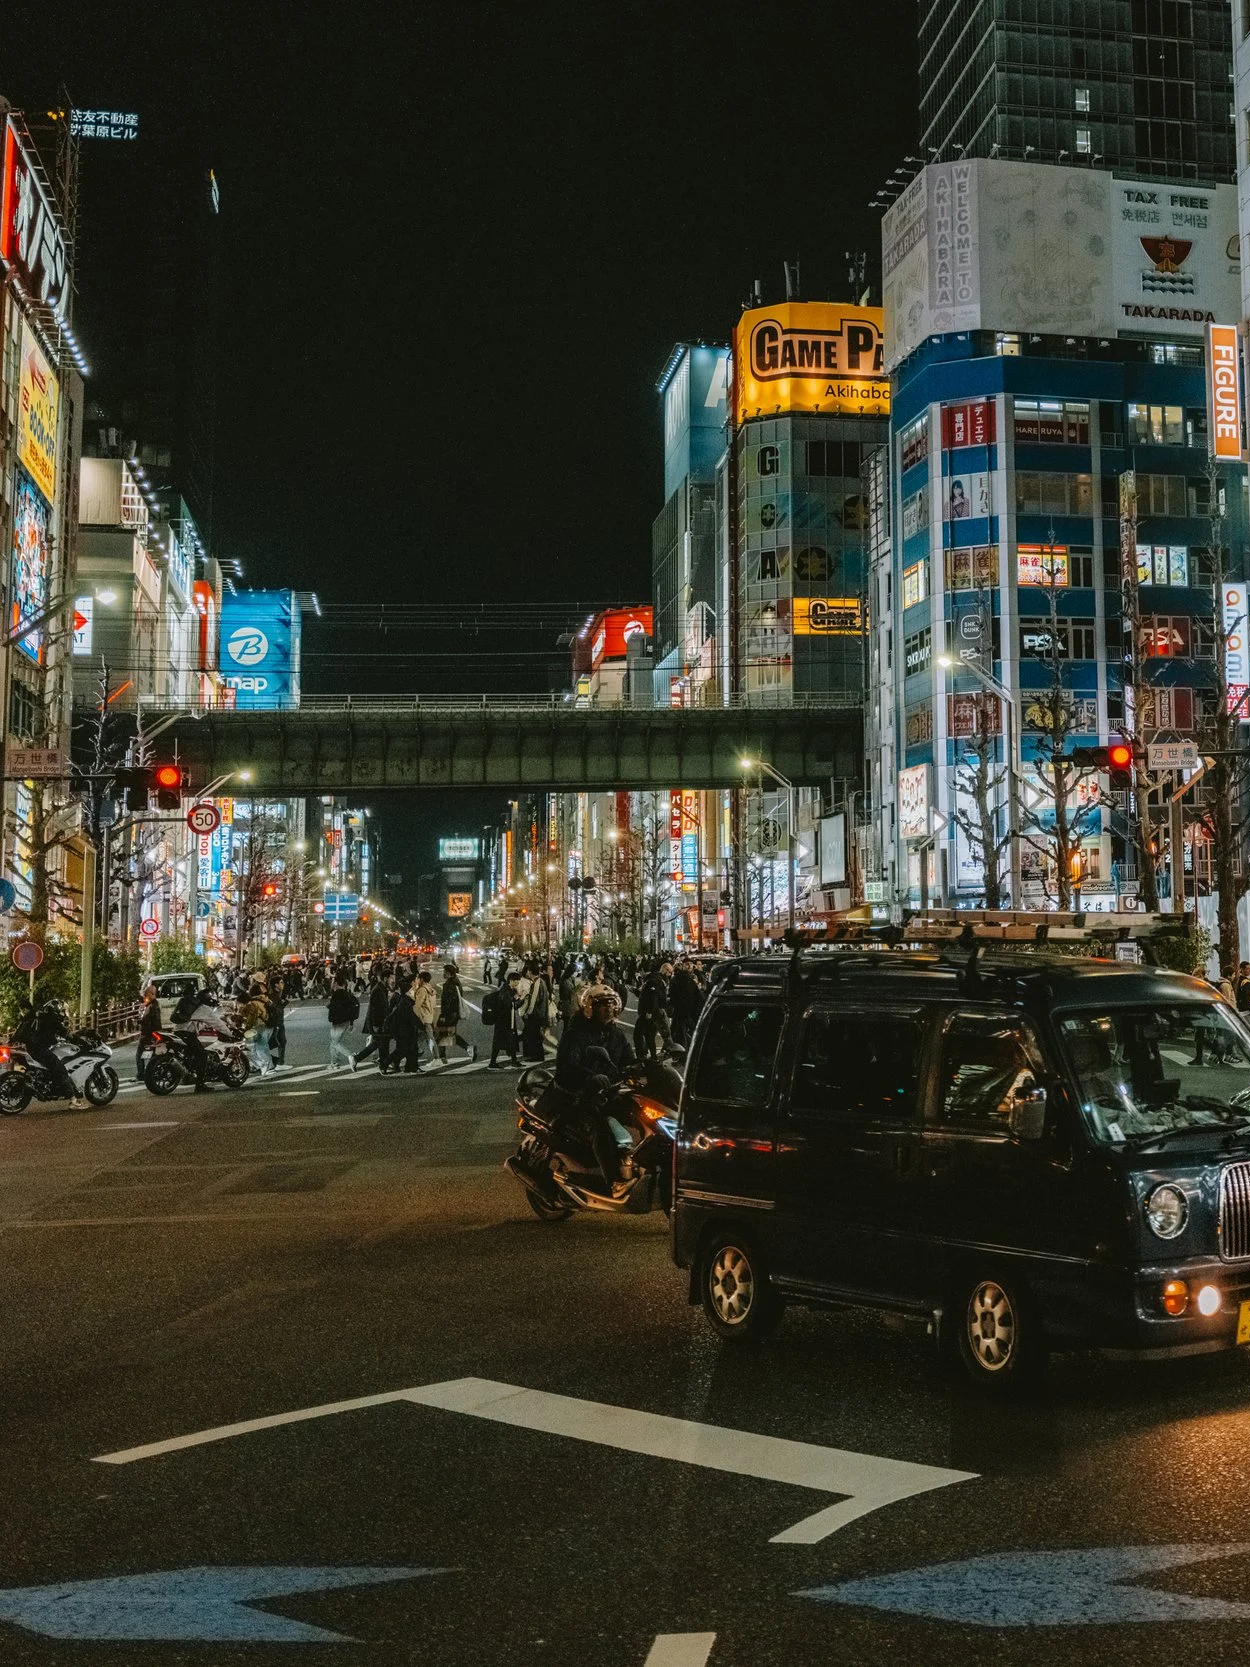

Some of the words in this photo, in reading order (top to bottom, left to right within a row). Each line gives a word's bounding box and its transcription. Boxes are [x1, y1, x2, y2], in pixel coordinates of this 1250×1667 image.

[1123, 190, 1159, 205] TAX
[1169, 195, 1209, 210] FREE
[1121, 304, 1217, 323] TAKARADA
[756, 325, 838, 372] GAME
[1213, 344, 1237, 440] FIGURE
[14, 753, 59, 765] 万世橋
[1152, 748, 1194, 760] 万世橋
[1180, 759, 1196, 768] Bridge
[195, 812, 214, 827] 50
